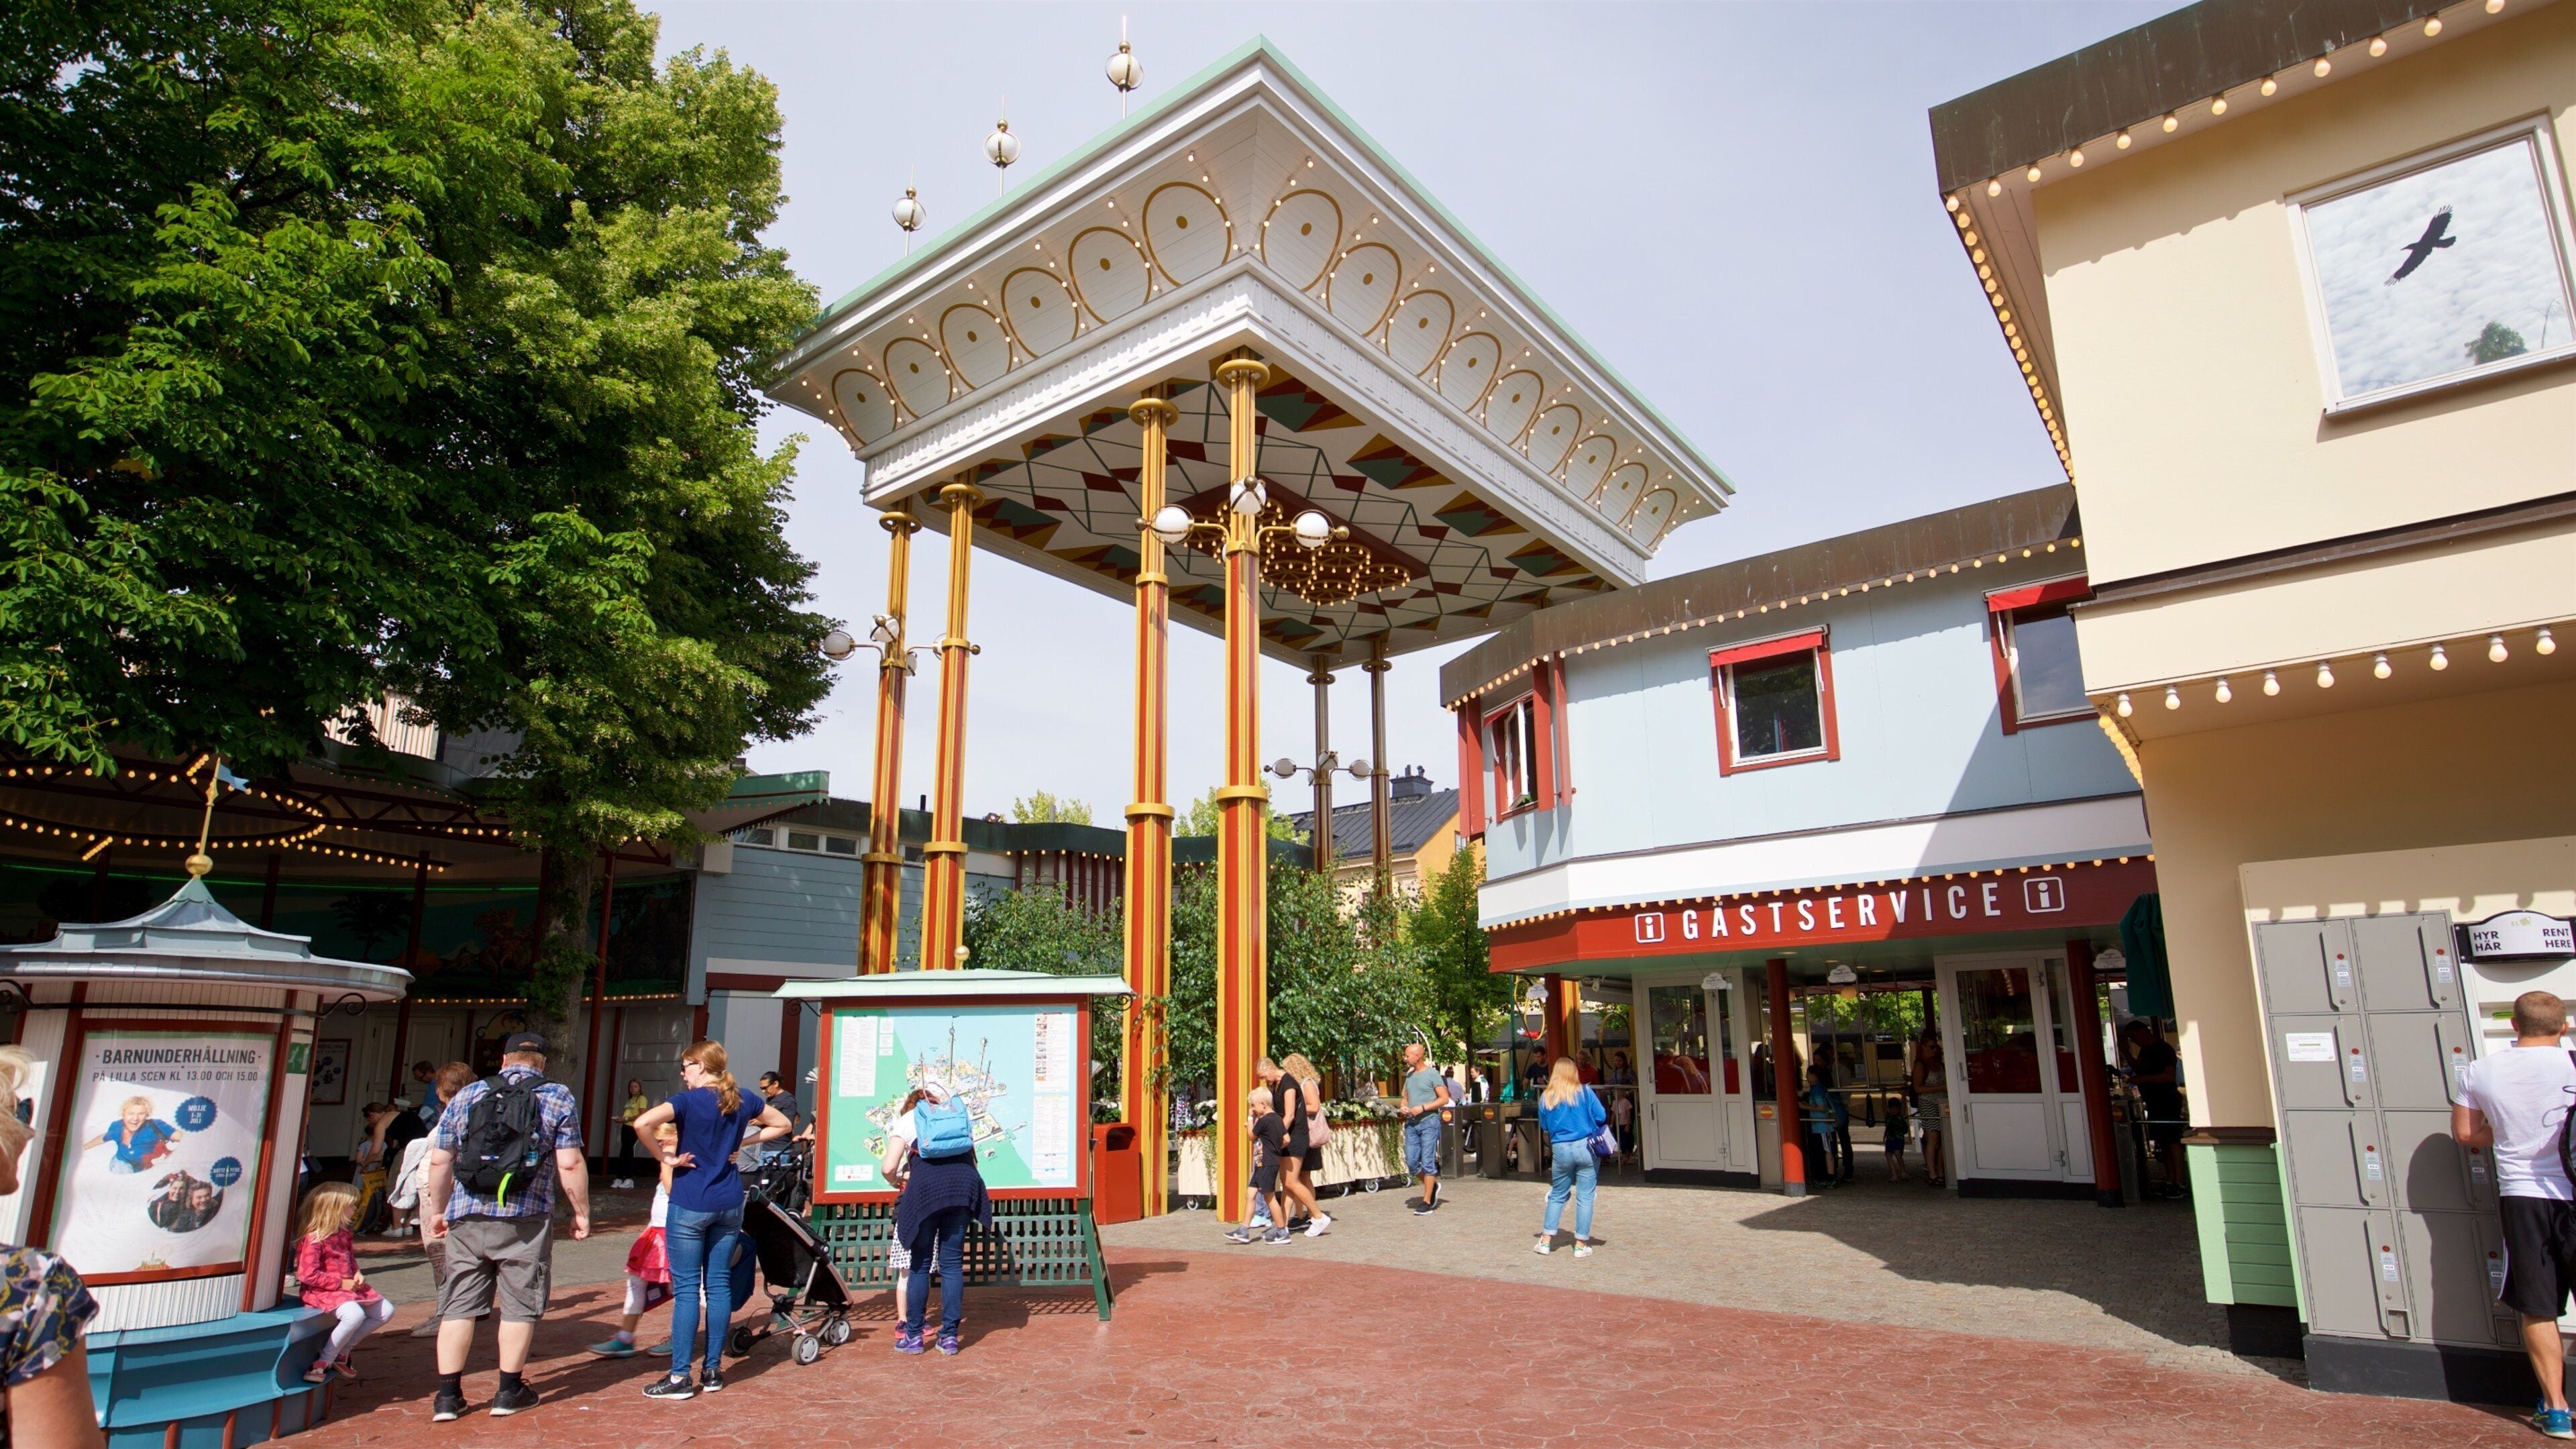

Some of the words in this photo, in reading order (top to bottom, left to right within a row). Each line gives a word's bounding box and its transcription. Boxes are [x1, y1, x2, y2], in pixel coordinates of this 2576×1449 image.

[1682, 882, 2001, 940] GÄSTSERVICE
[2473, 930, 2500, 941] HYR
[2542, 928, 2569, 937] RENT
[2475, 940, 2502, 952] HÄR
[2544, 939, 2571, 948] HERE
[103, 1045, 256, 1064] BARNUNDERHÅLLNING
[93, 1071, 106, 1082] PÅ
[110, 1072, 136, 1082] LILLA
[140, 1071, 166, 1081] SCEN
[169, 1071, 181, 1081] KL
[186, 1071, 212, 1081] 13.00
[215, 1071, 233, 1081] OCH
[237, 1071, 258, 1081] 15.00
